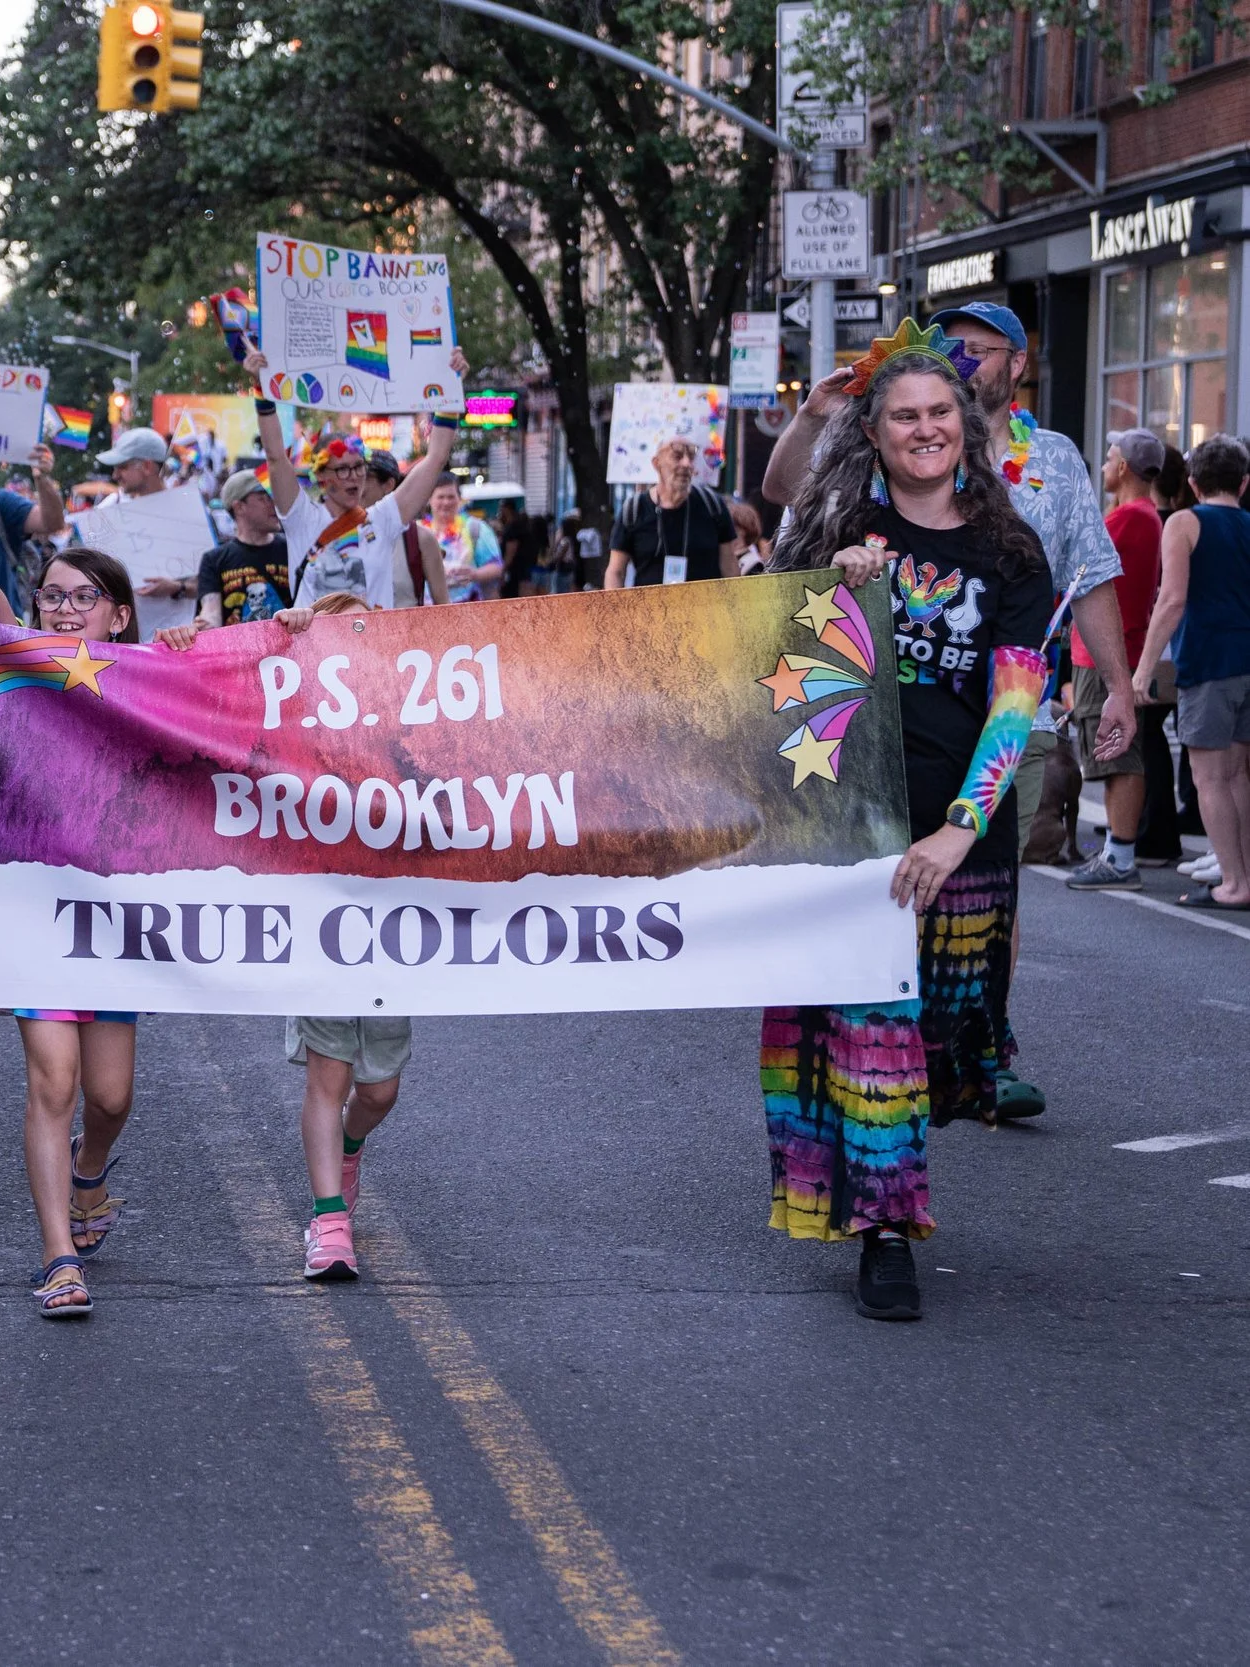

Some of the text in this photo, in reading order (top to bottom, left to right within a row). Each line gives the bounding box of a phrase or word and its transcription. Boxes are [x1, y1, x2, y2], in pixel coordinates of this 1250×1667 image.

[795, 224, 856, 236] ALLOWED
[1090, 195, 1196, 262] LaserAway
[266, 239, 446, 280] STOP BANNING
[791, 257, 861, 271] FULL LANE
[803, 241, 848, 254] USE OF
[281, 278, 324, 301] OUR
[379, 280, 428, 296] BOOKS
[927, 251, 995, 295] FRAMEBRIDGE
[836, 302, 868, 315] WAY
[326, 372, 400, 408] LOVE
[894, 634, 978, 671] TO BE
[259, 643, 504, 729] P.S. 261
[211, 770, 579, 850] BROOKLYN
[54, 898, 684, 966] TRUE COLORS
